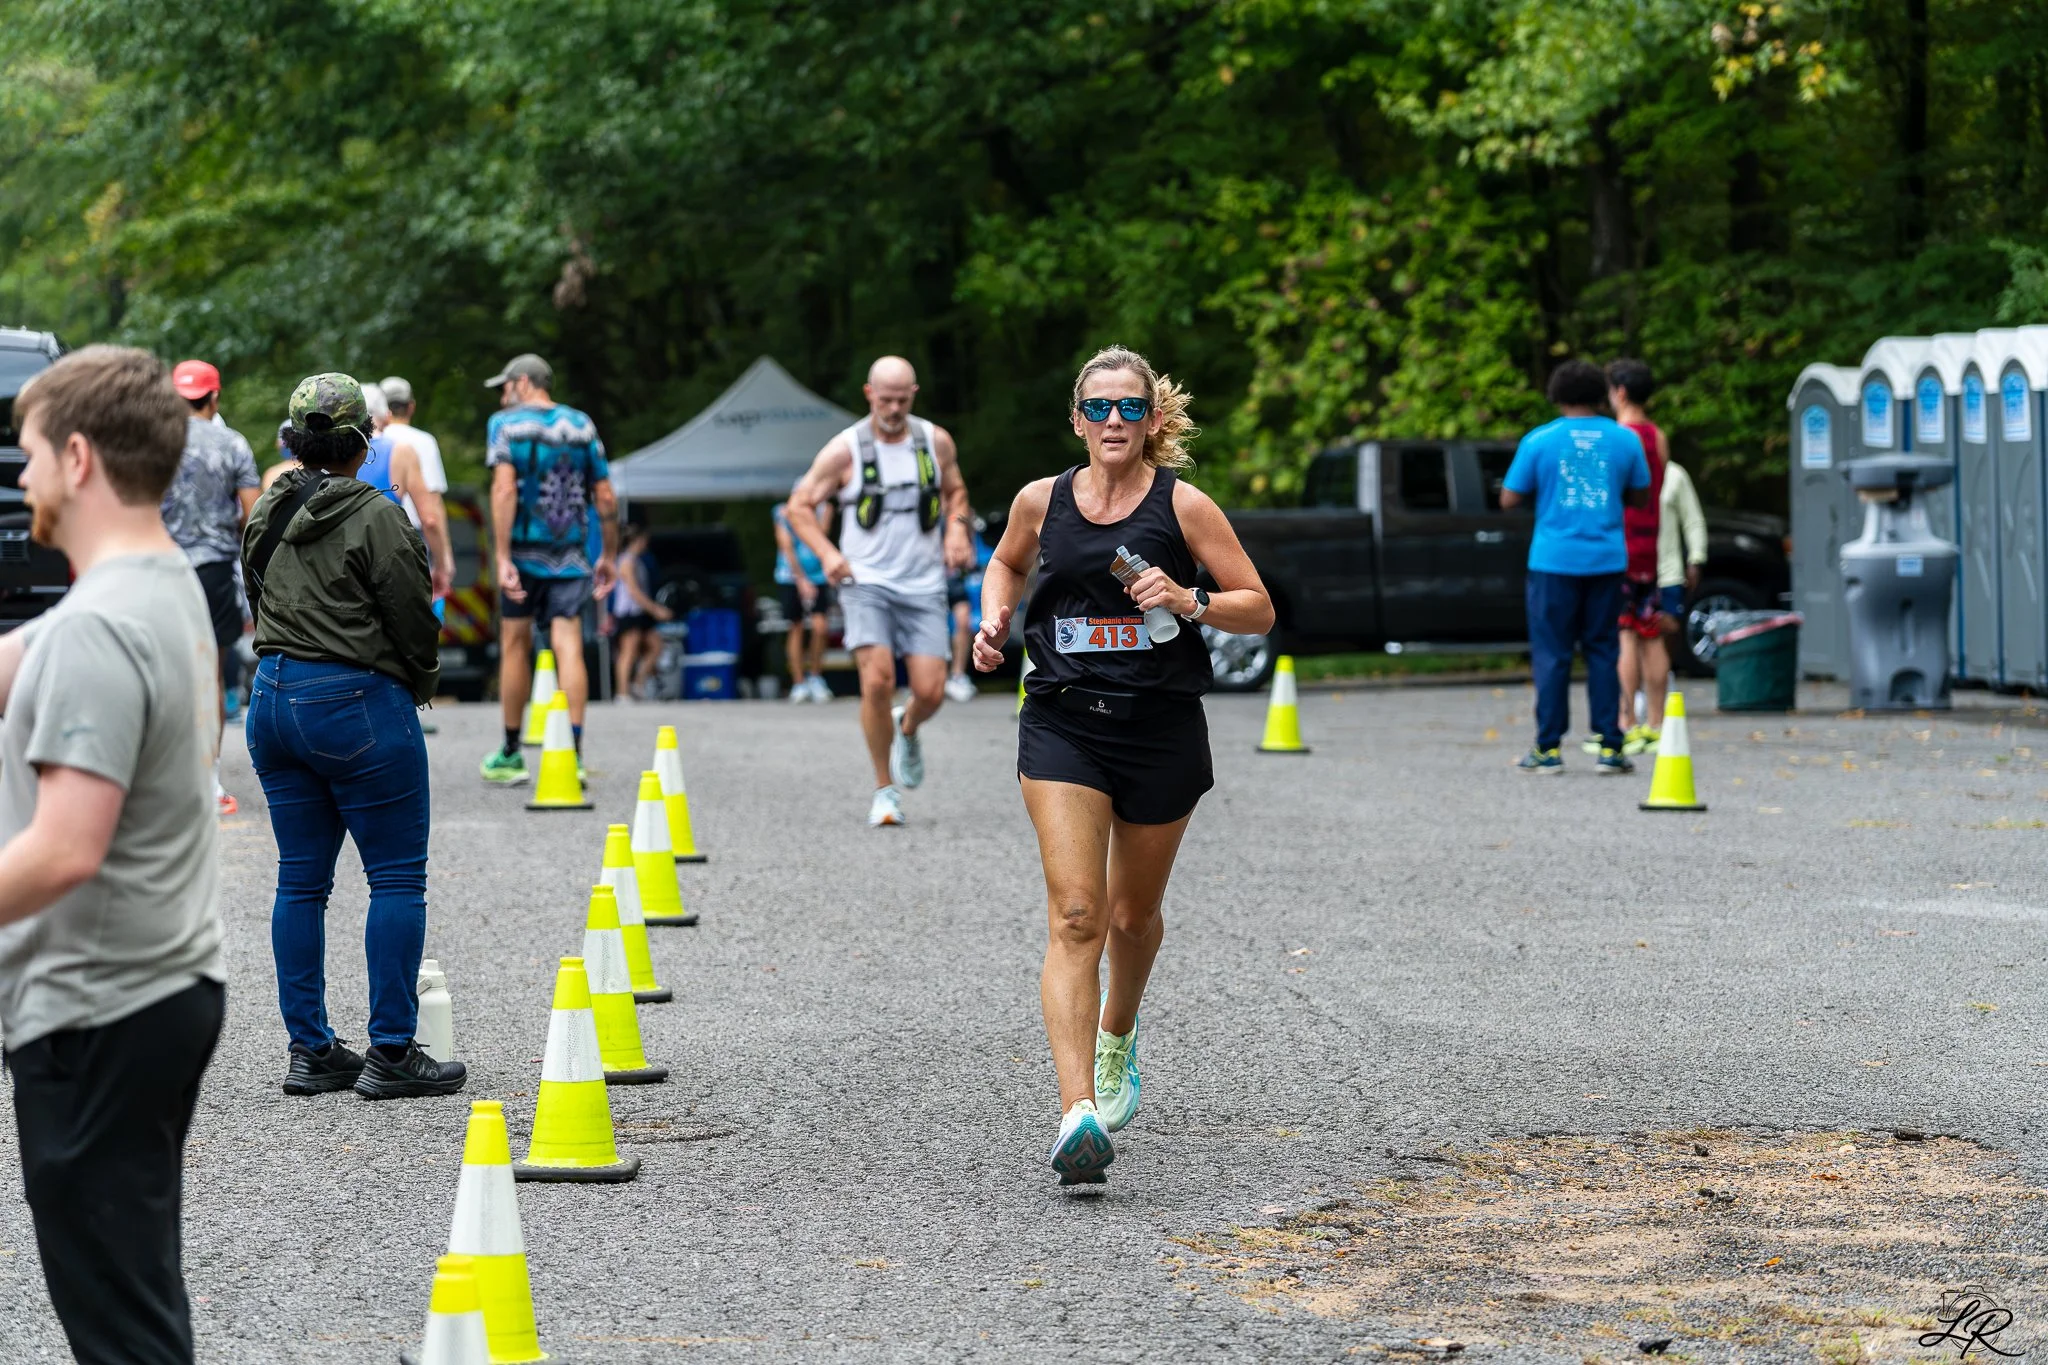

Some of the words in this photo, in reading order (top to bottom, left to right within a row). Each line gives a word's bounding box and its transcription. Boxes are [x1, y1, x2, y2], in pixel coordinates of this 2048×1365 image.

[1088, 617, 1122, 626] Stephanie
[1123, 616, 1143, 625] Nixon
[1088, 625, 1139, 649] 413
